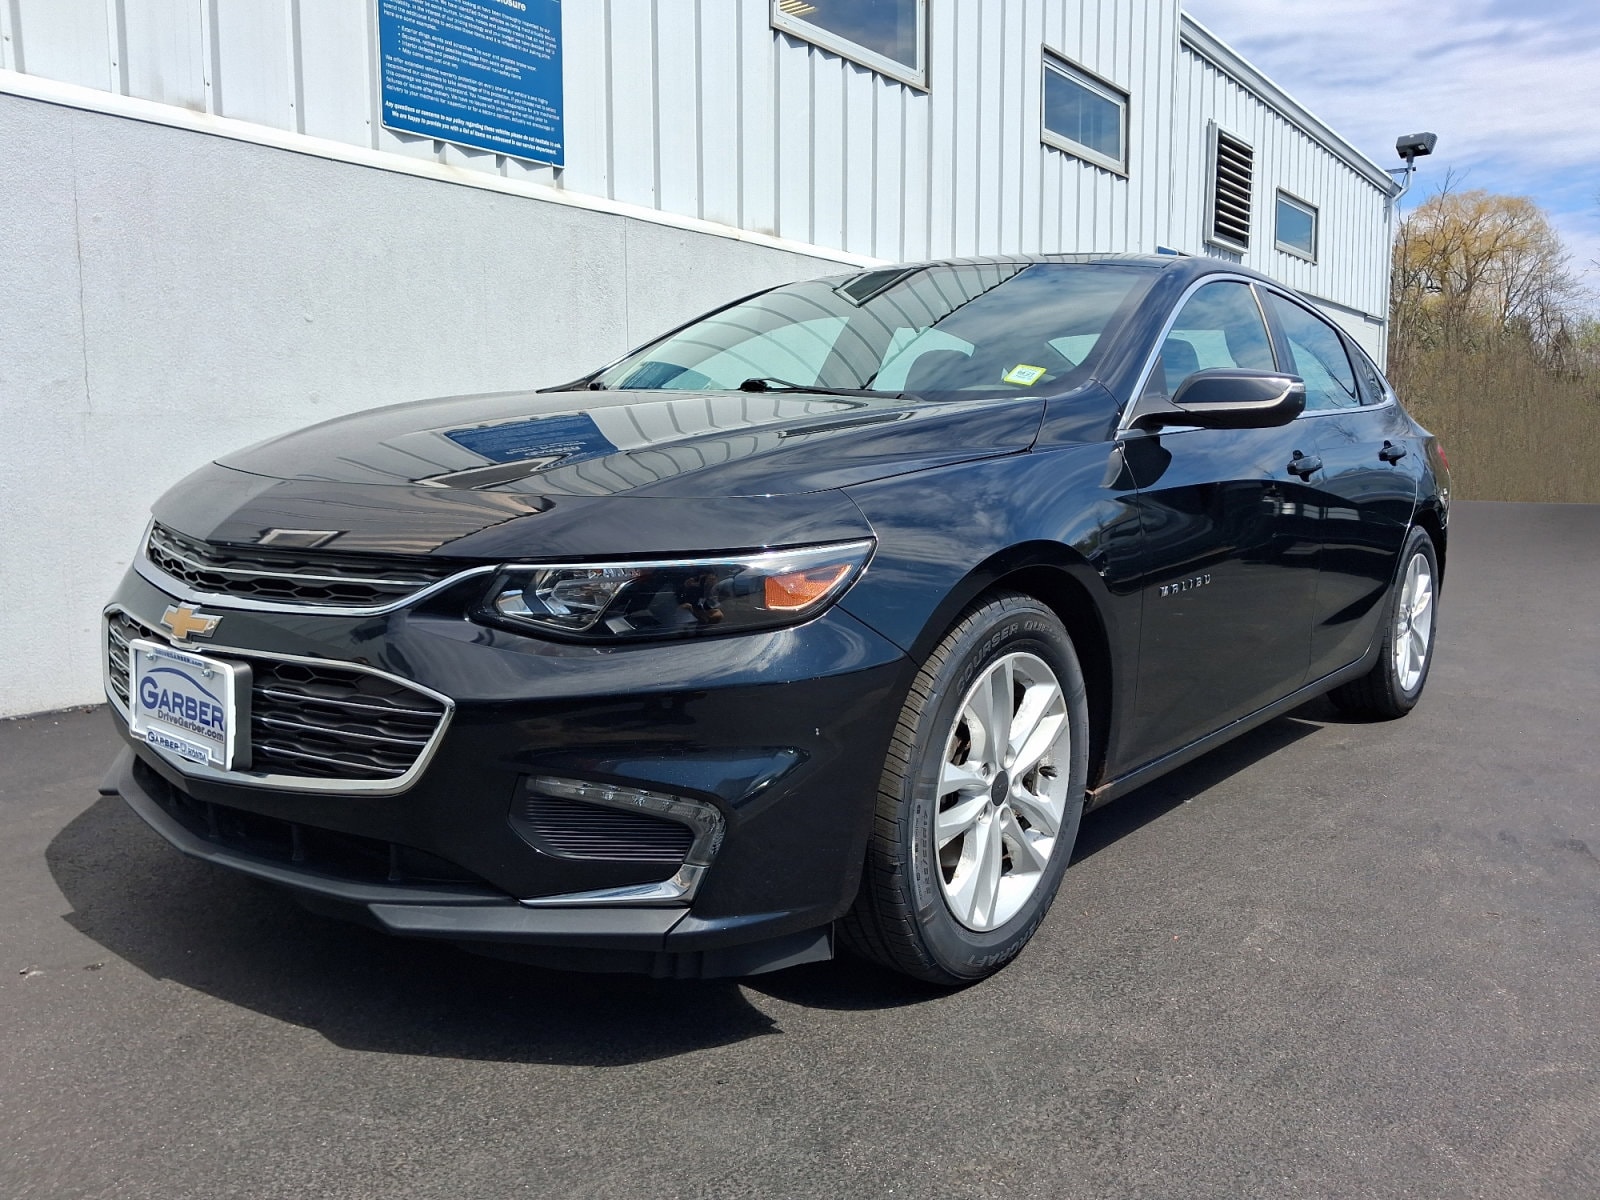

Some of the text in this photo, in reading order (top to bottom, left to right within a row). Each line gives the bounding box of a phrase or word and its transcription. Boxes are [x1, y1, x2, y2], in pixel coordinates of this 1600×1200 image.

[1160, 574, 1211, 598] MALIBU
[140, 676, 224, 731] GARBER
[158, 709, 224, 741] DriveGarber.com
[148, 731, 179, 749] GARBER
